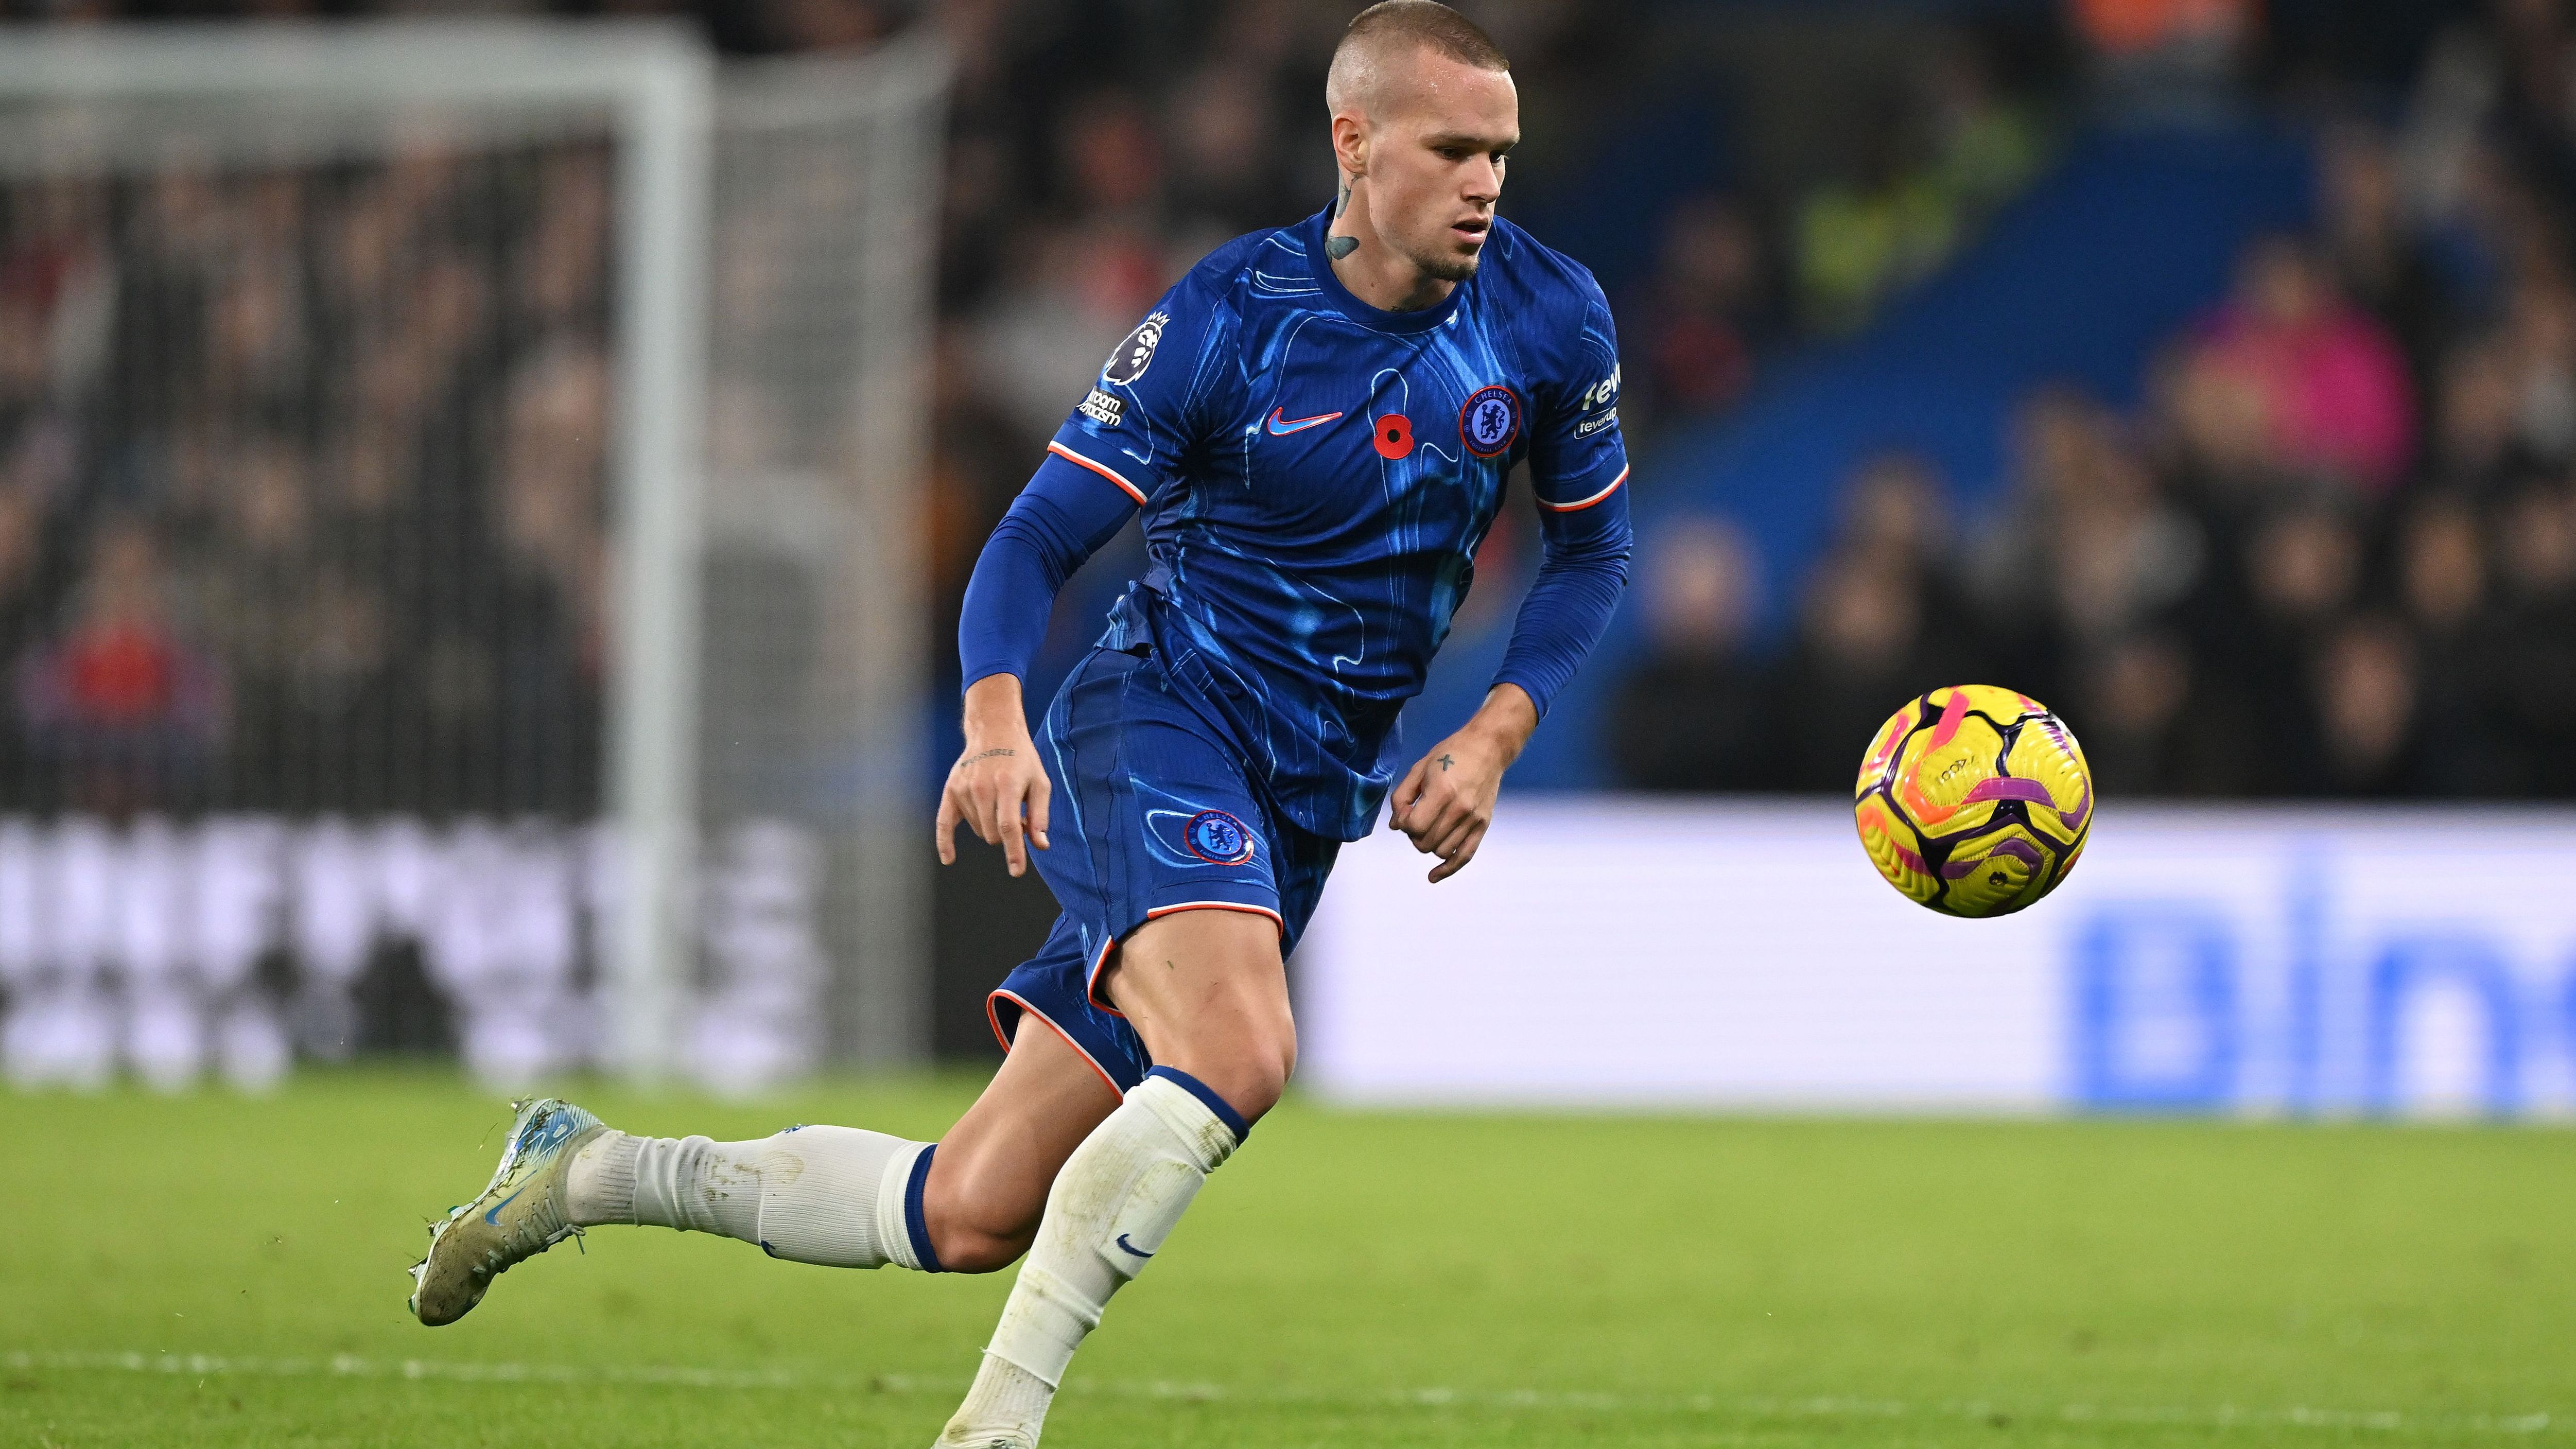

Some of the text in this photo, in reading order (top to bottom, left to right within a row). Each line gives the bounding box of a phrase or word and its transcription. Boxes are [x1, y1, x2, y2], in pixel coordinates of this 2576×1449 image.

[1091, 391, 1121, 412] room
[1475, 390, 1511, 405] CHELSEA
[2069, 844, 2576, 1107] Bin
